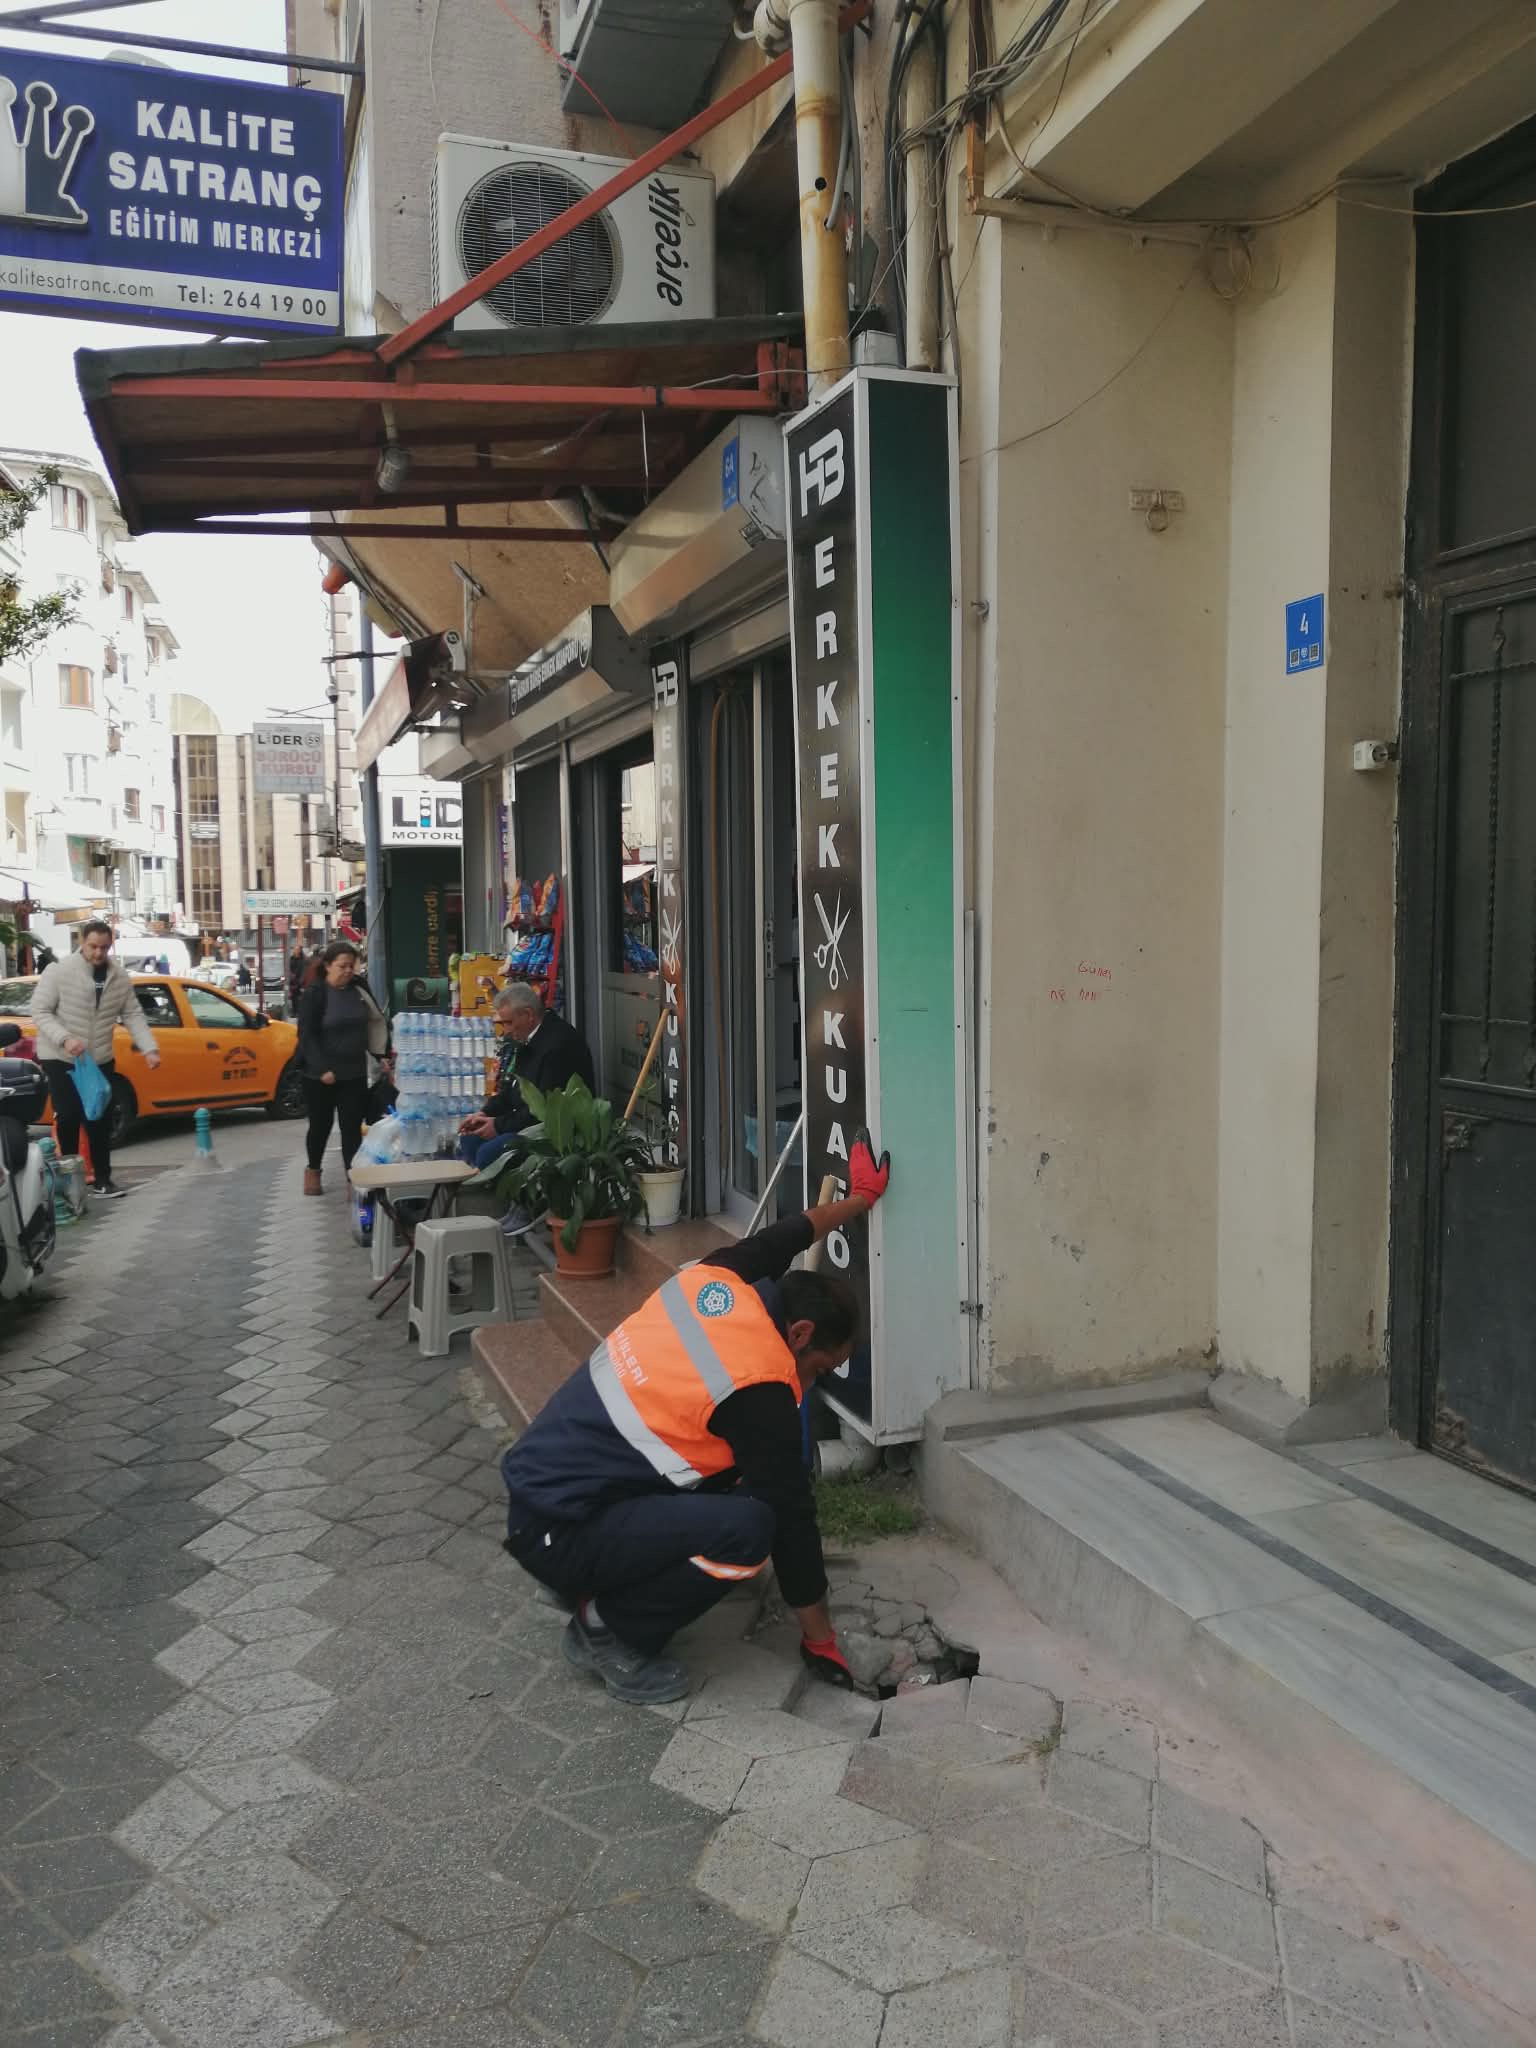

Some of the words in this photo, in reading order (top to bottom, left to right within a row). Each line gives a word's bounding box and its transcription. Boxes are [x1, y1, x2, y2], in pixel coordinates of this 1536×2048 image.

[137, 100, 295, 157] KALİTE
[108, 151, 322, 222] SATRANÇ
[109, 205, 199, 244] EĞİTİM
[213, 220, 321, 259] MERKEZİ
[648, 177, 689, 307] arçelik
[177, 284, 214, 304] Tel:
[223, 290, 261, 309] 264
[271, 294, 294, 312] 19
[302, 298, 327, 316] 00
[1299, 612, 1309, 635] 4
[814, 536, 841, 868] ERKEK
[661, 725, 676, 897] ERKEK
[664, 981, 680, 1165] KUAFÖR
[824, 1010, 850, 1379] KUAÖ
